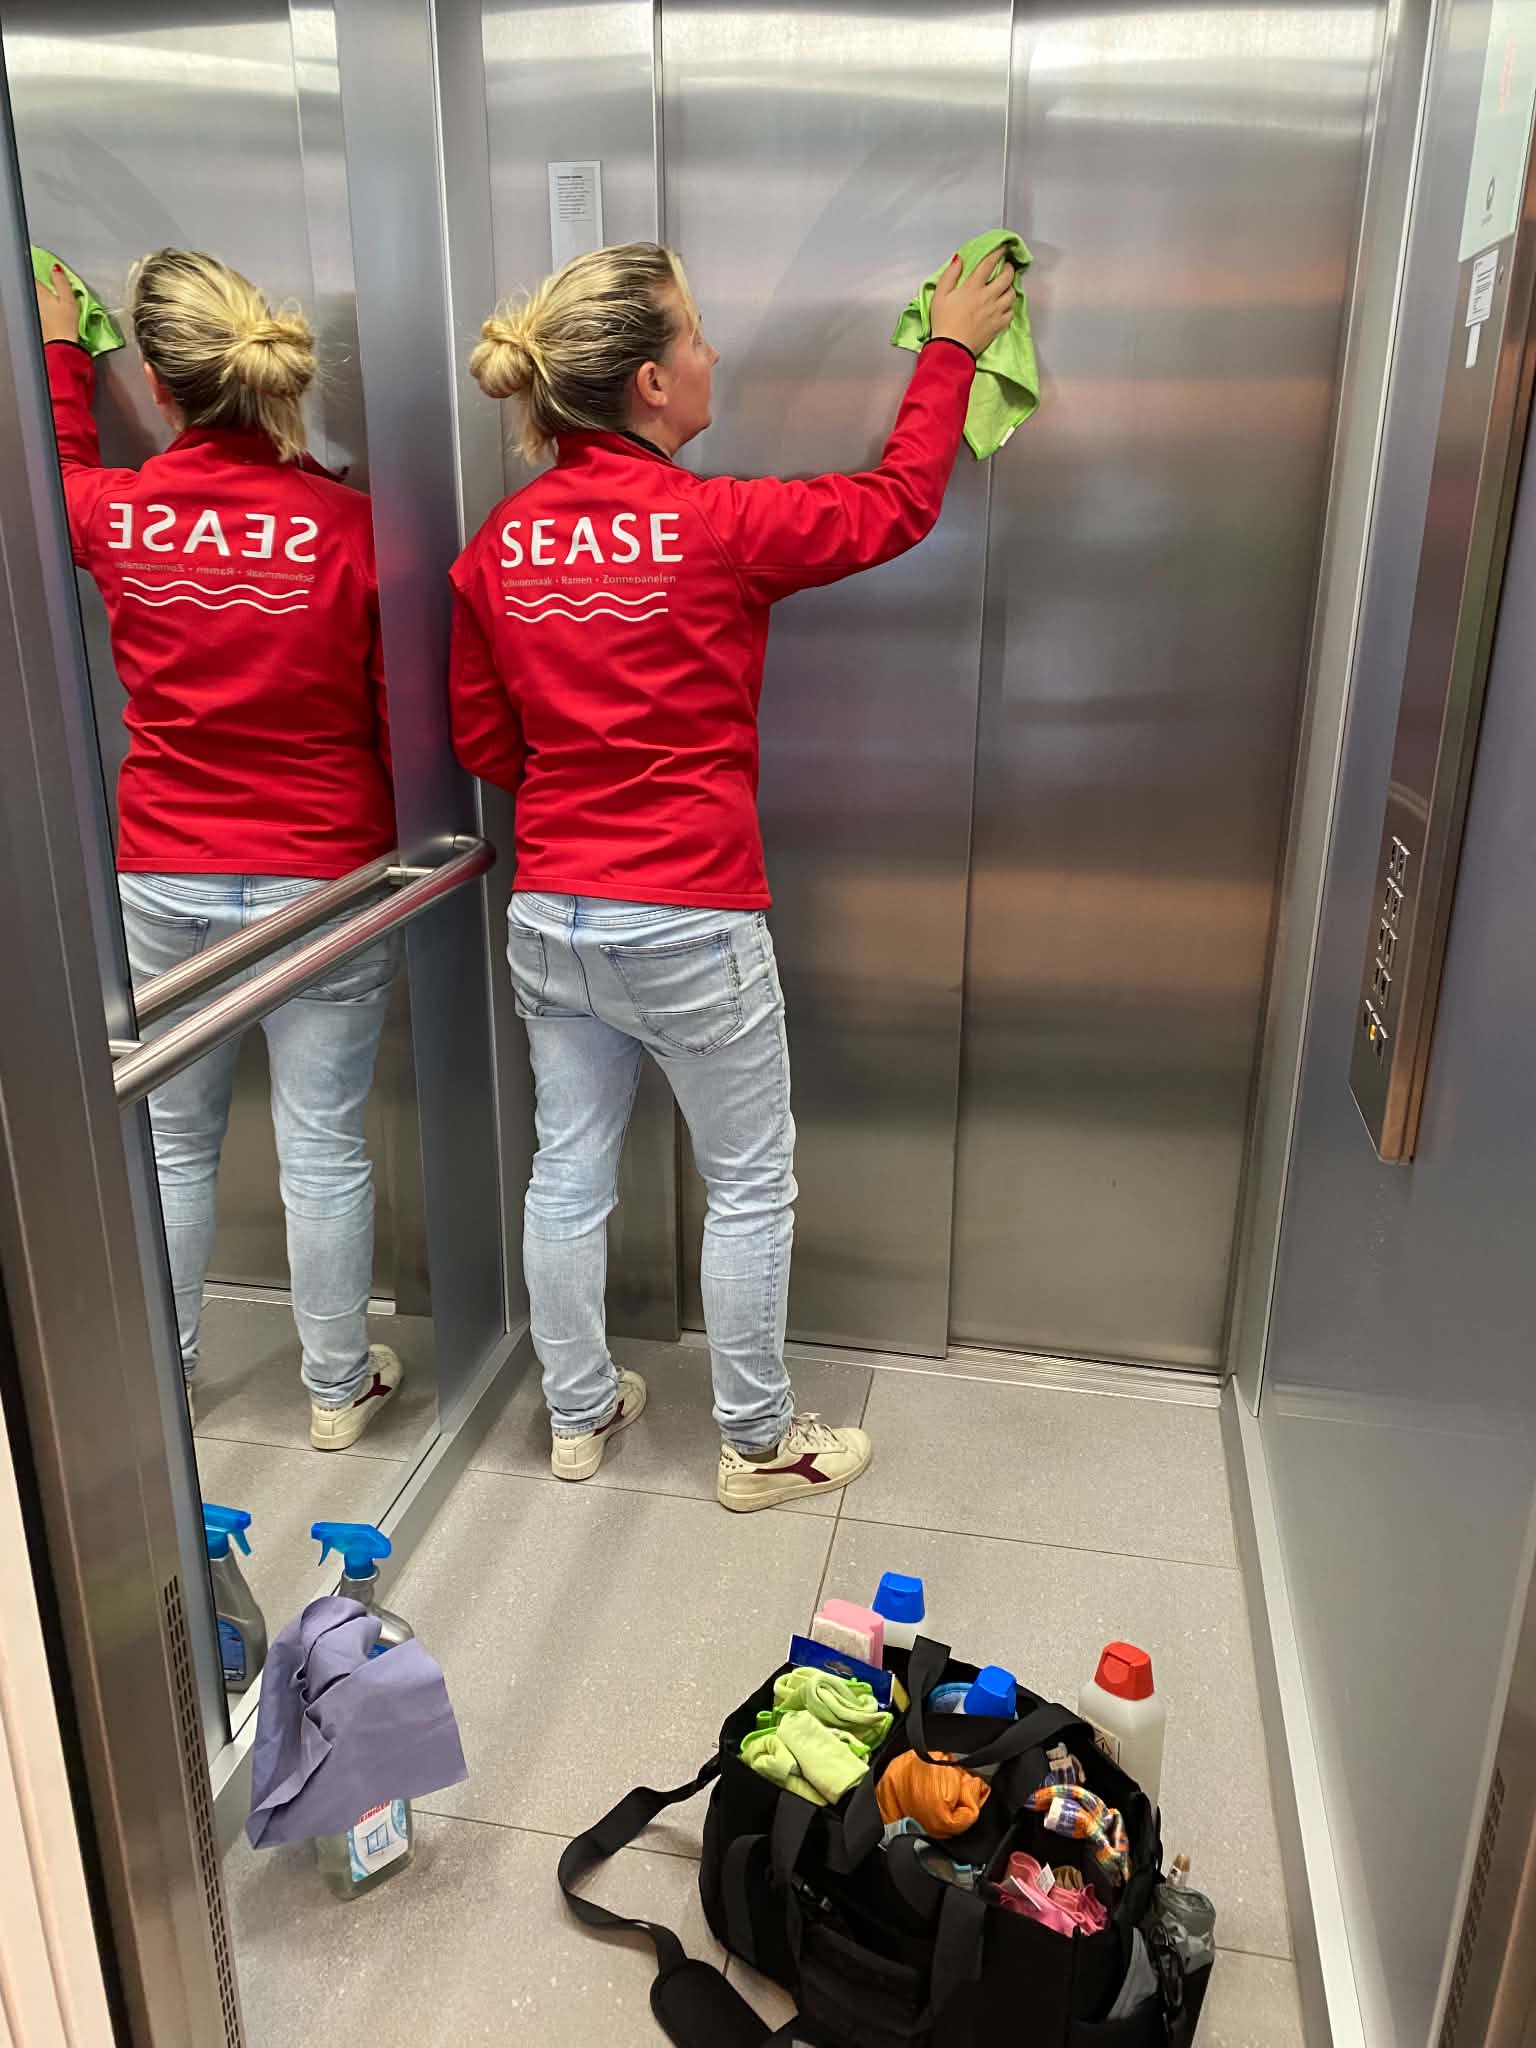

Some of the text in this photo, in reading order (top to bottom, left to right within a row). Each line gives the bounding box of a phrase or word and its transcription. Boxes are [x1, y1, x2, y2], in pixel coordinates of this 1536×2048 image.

[500, 512, 684, 568] SEASE
[561, 575, 592, 585] Ramen
[602, 572, 676, 585] Zonnepanelen
